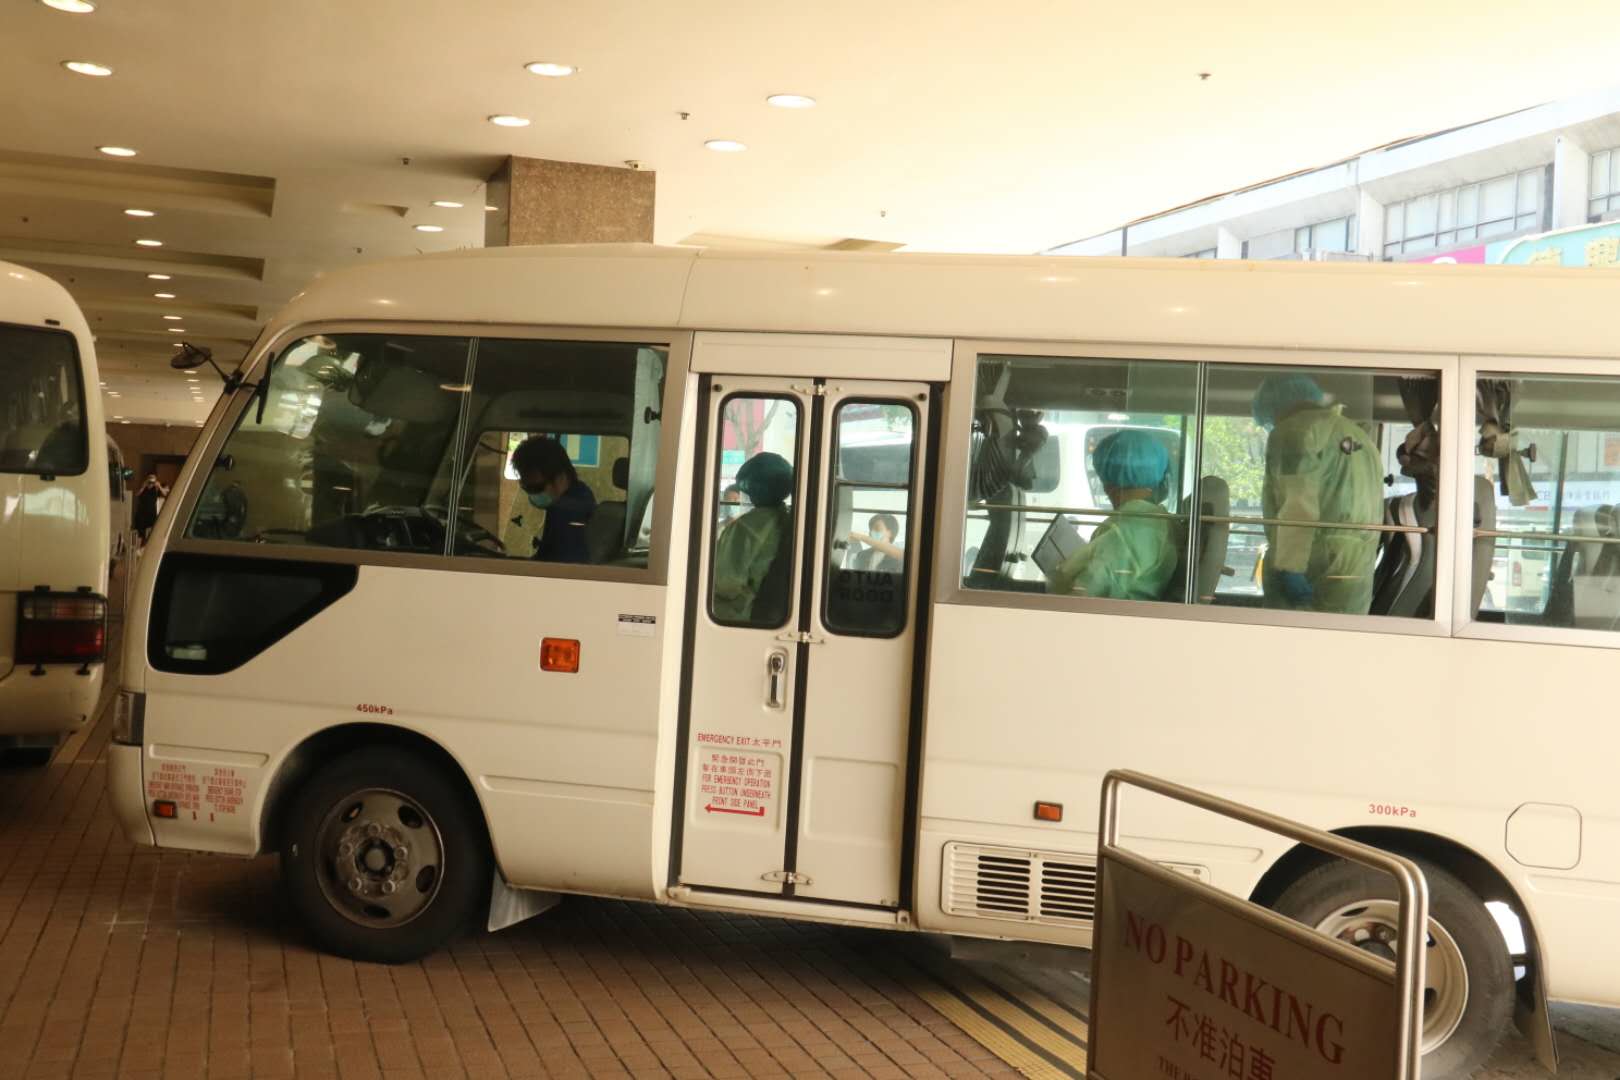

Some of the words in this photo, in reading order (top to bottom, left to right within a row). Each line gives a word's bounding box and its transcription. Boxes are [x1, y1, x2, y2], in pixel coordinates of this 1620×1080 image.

[356, 704, 393, 715] 450kPa
[698, 733, 734, 744] EMERGENCY
[736, 737, 750, 745] EXIT
[703, 774, 712, 782] FOR
[714, 775, 742, 785] EMERGENCY
[744, 779, 771, 788] OPERATION
[701, 784, 716, 794] PRESS
[719, 786, 738, 796] BUTTON
[740, 789, 772, 799] UNDERNEATH
[712, 797, 727, 806] FRONT
[730, 798, 741, 807] SIDE
[743, 799, 759, 809] PANEL
[1368, 803, 1416, 818] 300kPa
[1124, 911, 1167, 964] NO
[1173, 936, 1346, 1065] PARKING
[1165, 995, 1277, 1080] 不准泊車
